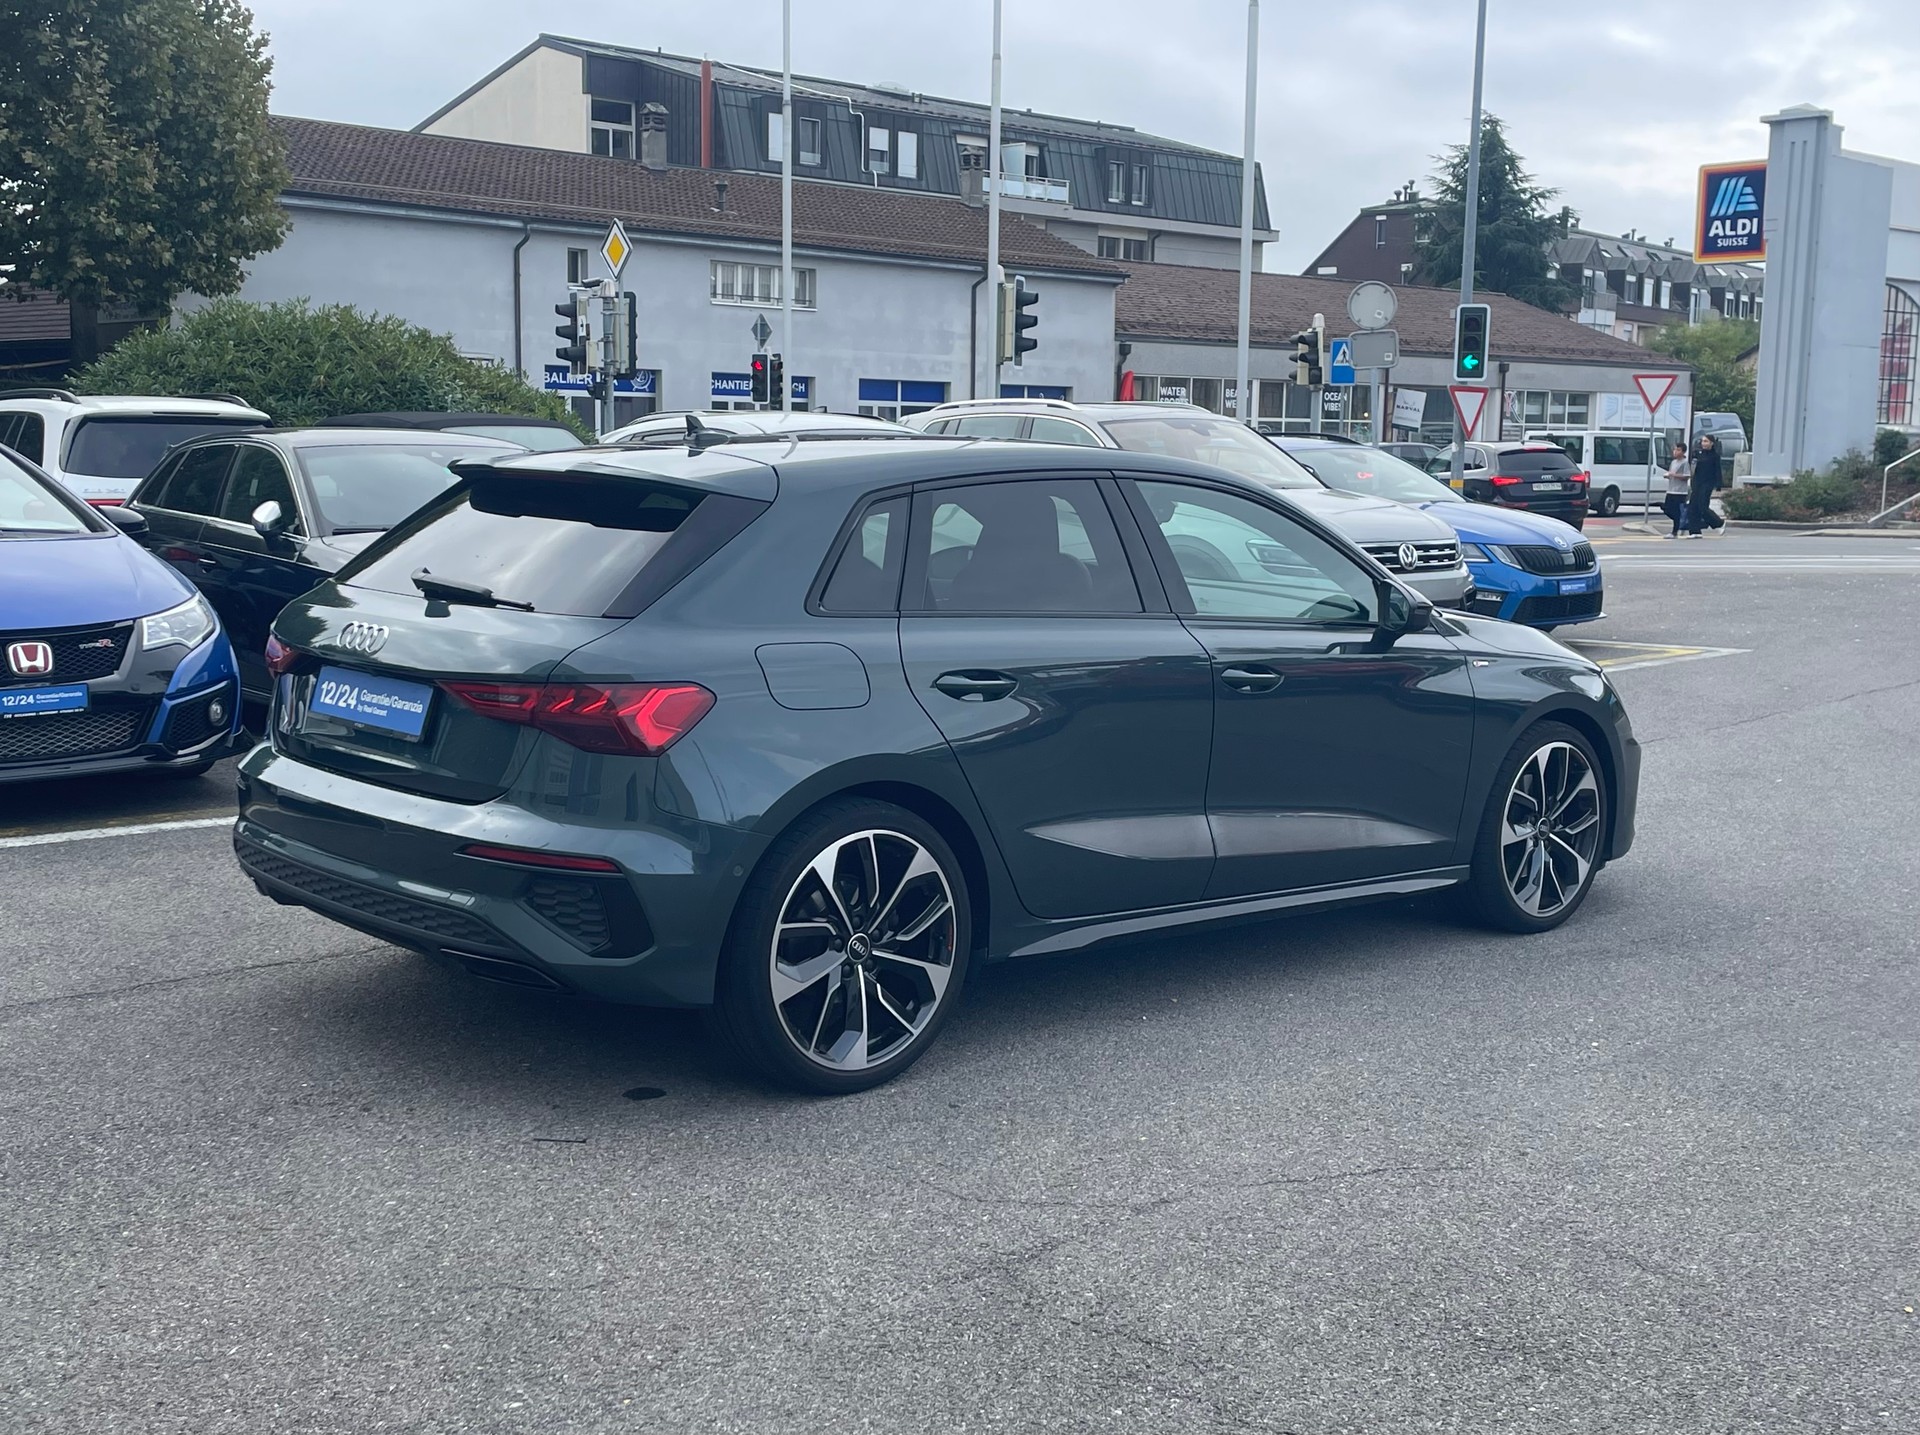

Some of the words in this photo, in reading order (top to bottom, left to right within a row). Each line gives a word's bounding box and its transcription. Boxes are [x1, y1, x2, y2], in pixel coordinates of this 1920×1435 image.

[1708, 217, 1759, 237] ALDI
[1717, 237, 1749, 247] SUISSE
[544, 371, 593, 385] BALMER
[1160, 386, 1187, 397] WATER
[2, 694, 34, 706] 12/24
[320, 680, 359, 710] 12/24
[360, 689, 423, 713] Garantie/Garanzia
